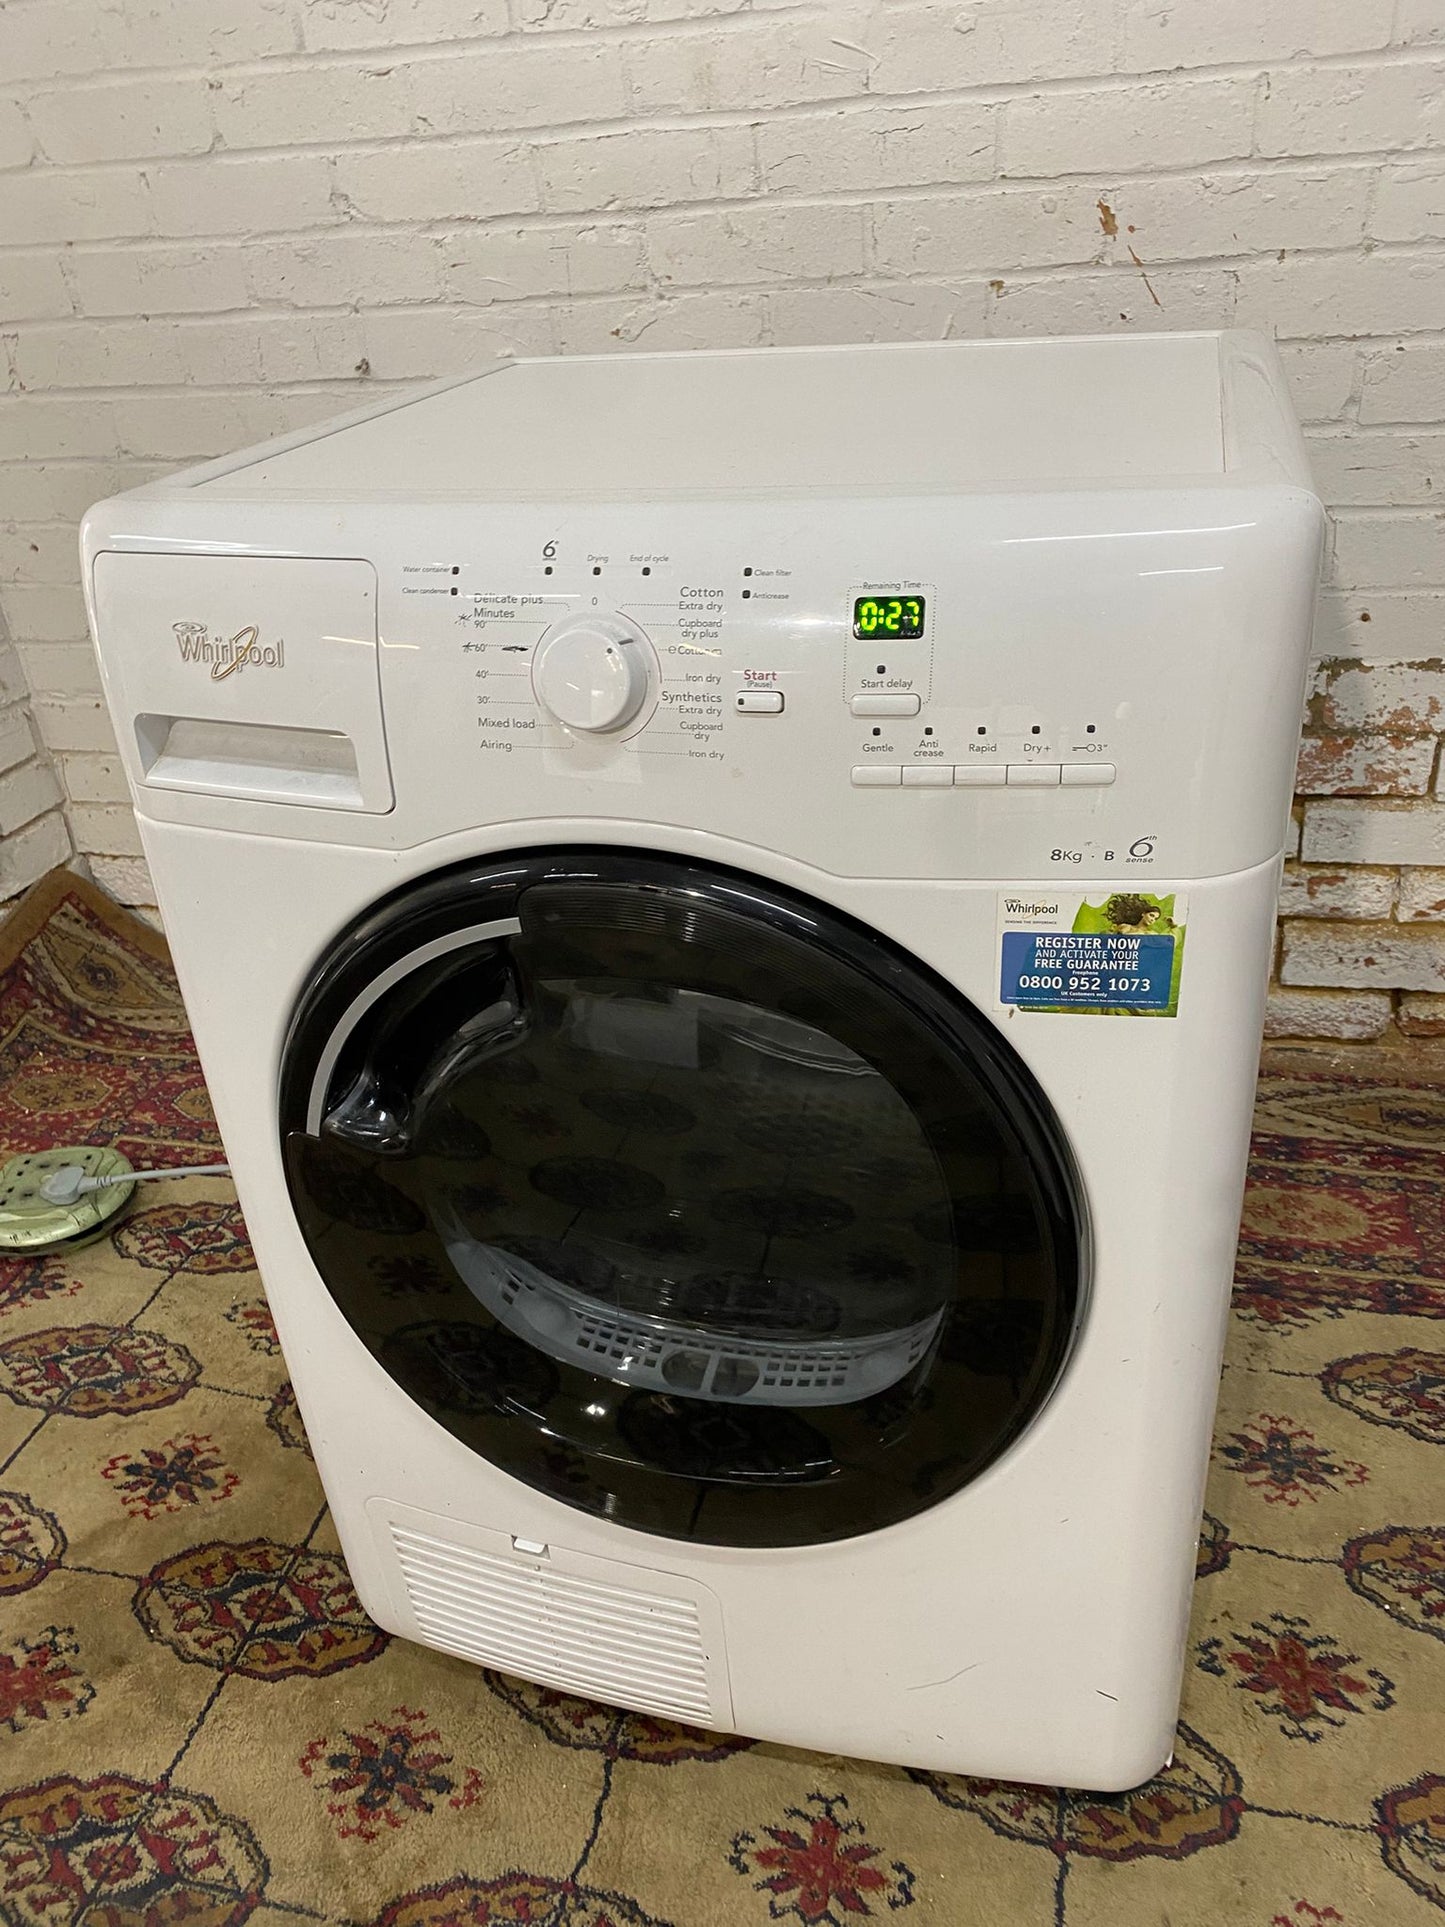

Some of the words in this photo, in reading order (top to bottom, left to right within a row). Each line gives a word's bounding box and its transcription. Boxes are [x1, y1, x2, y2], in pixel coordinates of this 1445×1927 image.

[587, 555, 609, 563] Drying
[652, 555, 669, 563] cycle
[754, 569, 774, 577] Clean
[680, 586, 724, 598] Cotton
[863, 582, 901, 591] Remaining
[474, 593, 518, 604] Delicate
[521, 594, 544, 606] plus
[592, 597, 598, 606] 0
[752, 592, 789, 600] Anticrease
[678, 601, 703, 611] Extra
[706, 601, 723, 613] dry
[474, 608, 515, 618] Minutes
[861, 601, 920, 631] 0:27
[678, 618, 723, 628] Cupboard
[681, 629, 697, 640] dry
[700, 629, 719, 639] plus
[176, 633, 285, 673] Whirlpool
[685, 673, 703, 682] Iron
[706, 673, 721, 684] dry
[743, 669, 777, 681] Start
[861, 679, 884, 688] Start
[887, 679, 913, 690] delay
[661, 690, 722, 704] Synthetics
[678, 705, 703, 714] Extra
[706, 705, 722, 717] dry
[478, 717, 510, 728] Mixed
[512, 718, 535, 729] load
[679, 721, 723, 732] Cupboard
[694, 731, 710, 742] dry
[480, 740, 512, 752] Airing
[862, 744, 894, 752] Gentle
[918, 740, 939, 748] Anti
[968, 744, 997, 754] Rapid
[689, 750, 707, 758] Iron
[708, 751, 725, 761] dry
[1050, 849, 1083, 864] 8Kg
[1104, 851, 1115, 861] B
[1006, 903, 1058, 916] Whirlpool
[1035, 937, 1101, 949] REGISTER
[1107, 938, 1141, 950] NOW
[1035, 949, 1056, 958] AND
[1060, 950, 1108, 959] ACTIVATE
[1112, 951, 1139, 960] YOUR
[1034, 958, 1062, 969] FREE
[1066, 960, 1139, 971] GUARANTEE
[1019, 975, 1063, 990] 0800
[1069, 976, 1101, 991] 952
[1108, 978, 1151, 992] 1073
